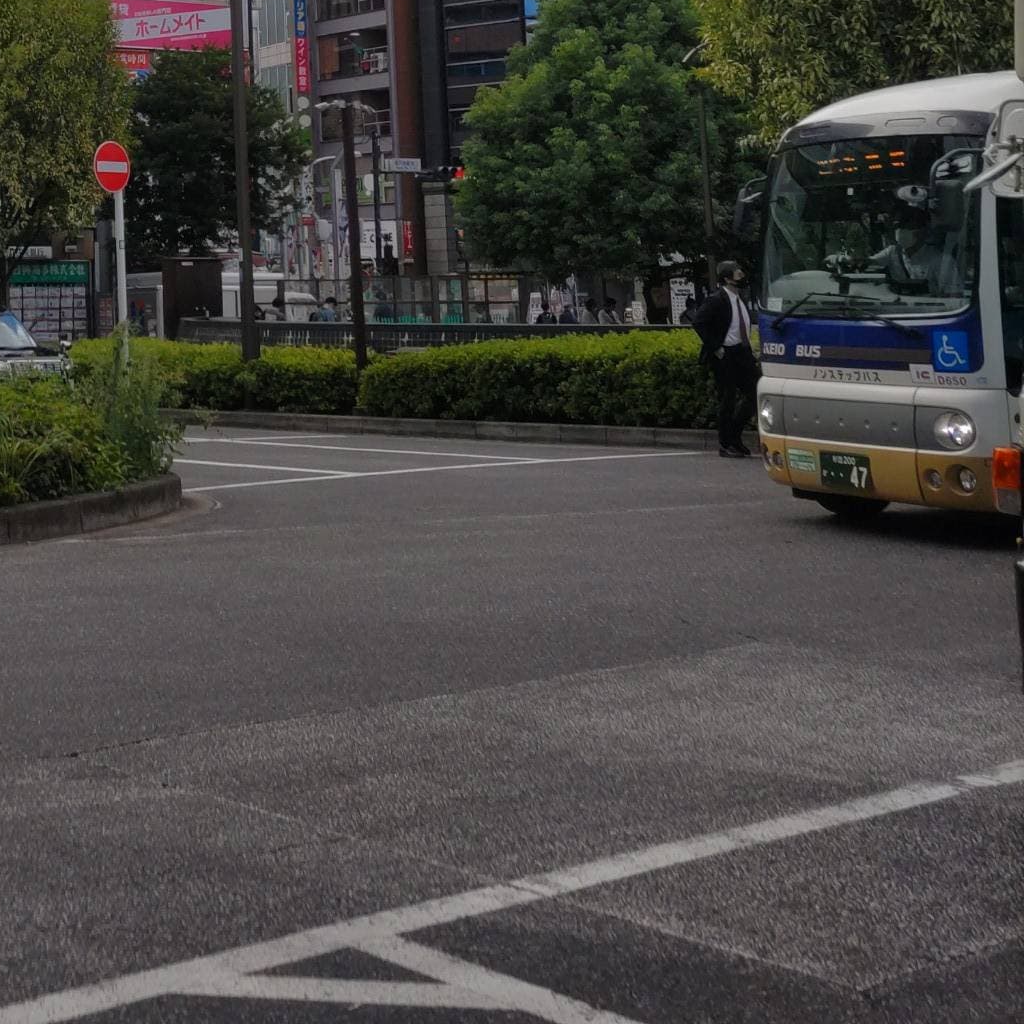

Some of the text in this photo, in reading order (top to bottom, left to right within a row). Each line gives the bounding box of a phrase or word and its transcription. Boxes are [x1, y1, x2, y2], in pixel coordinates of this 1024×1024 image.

[136, 13, 206, 38] ホームメイト
[796, 344, 822, 358] BUS
[850, 465, 868, 489] 47
